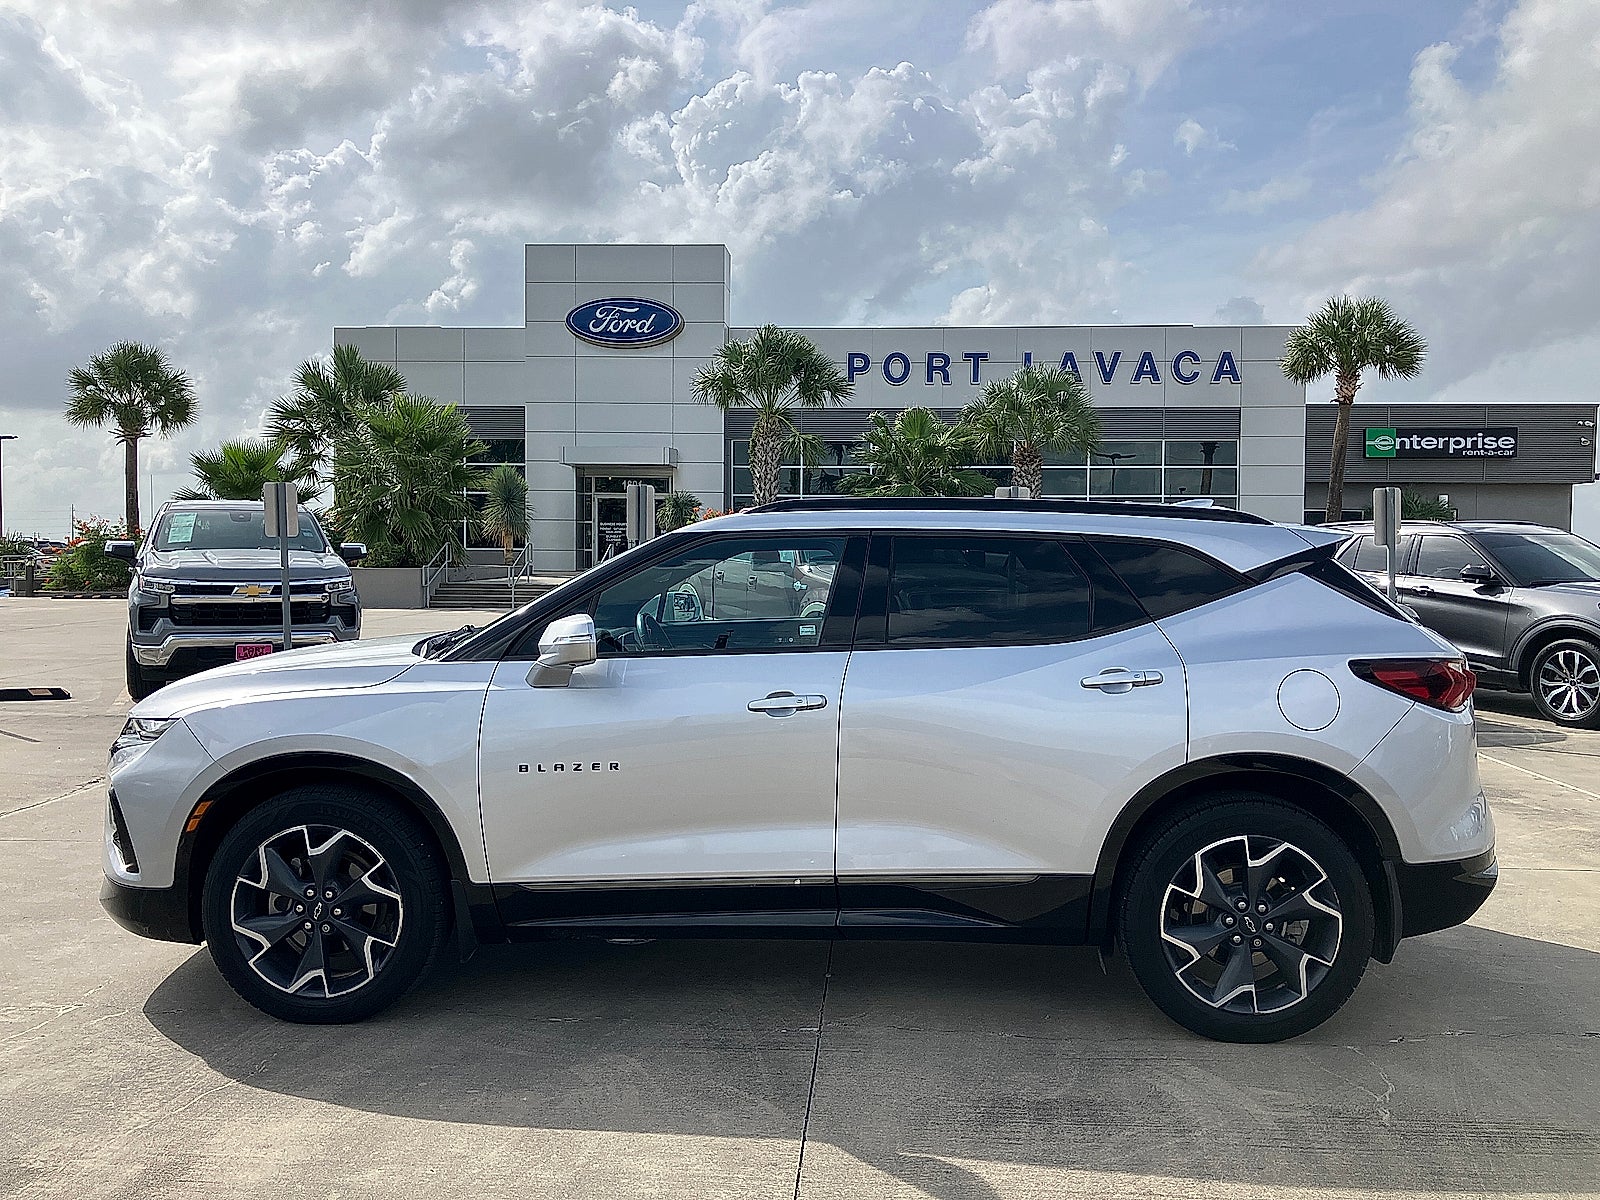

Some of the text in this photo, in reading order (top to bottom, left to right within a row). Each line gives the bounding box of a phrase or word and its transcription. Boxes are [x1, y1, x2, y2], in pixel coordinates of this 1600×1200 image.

[588, 305, 657, 333] Ford
[847, 351, 990, 386] PORT
[1373, 432, 1516, 453] enterprise
[518, 762, 620, 773] BLAZER
